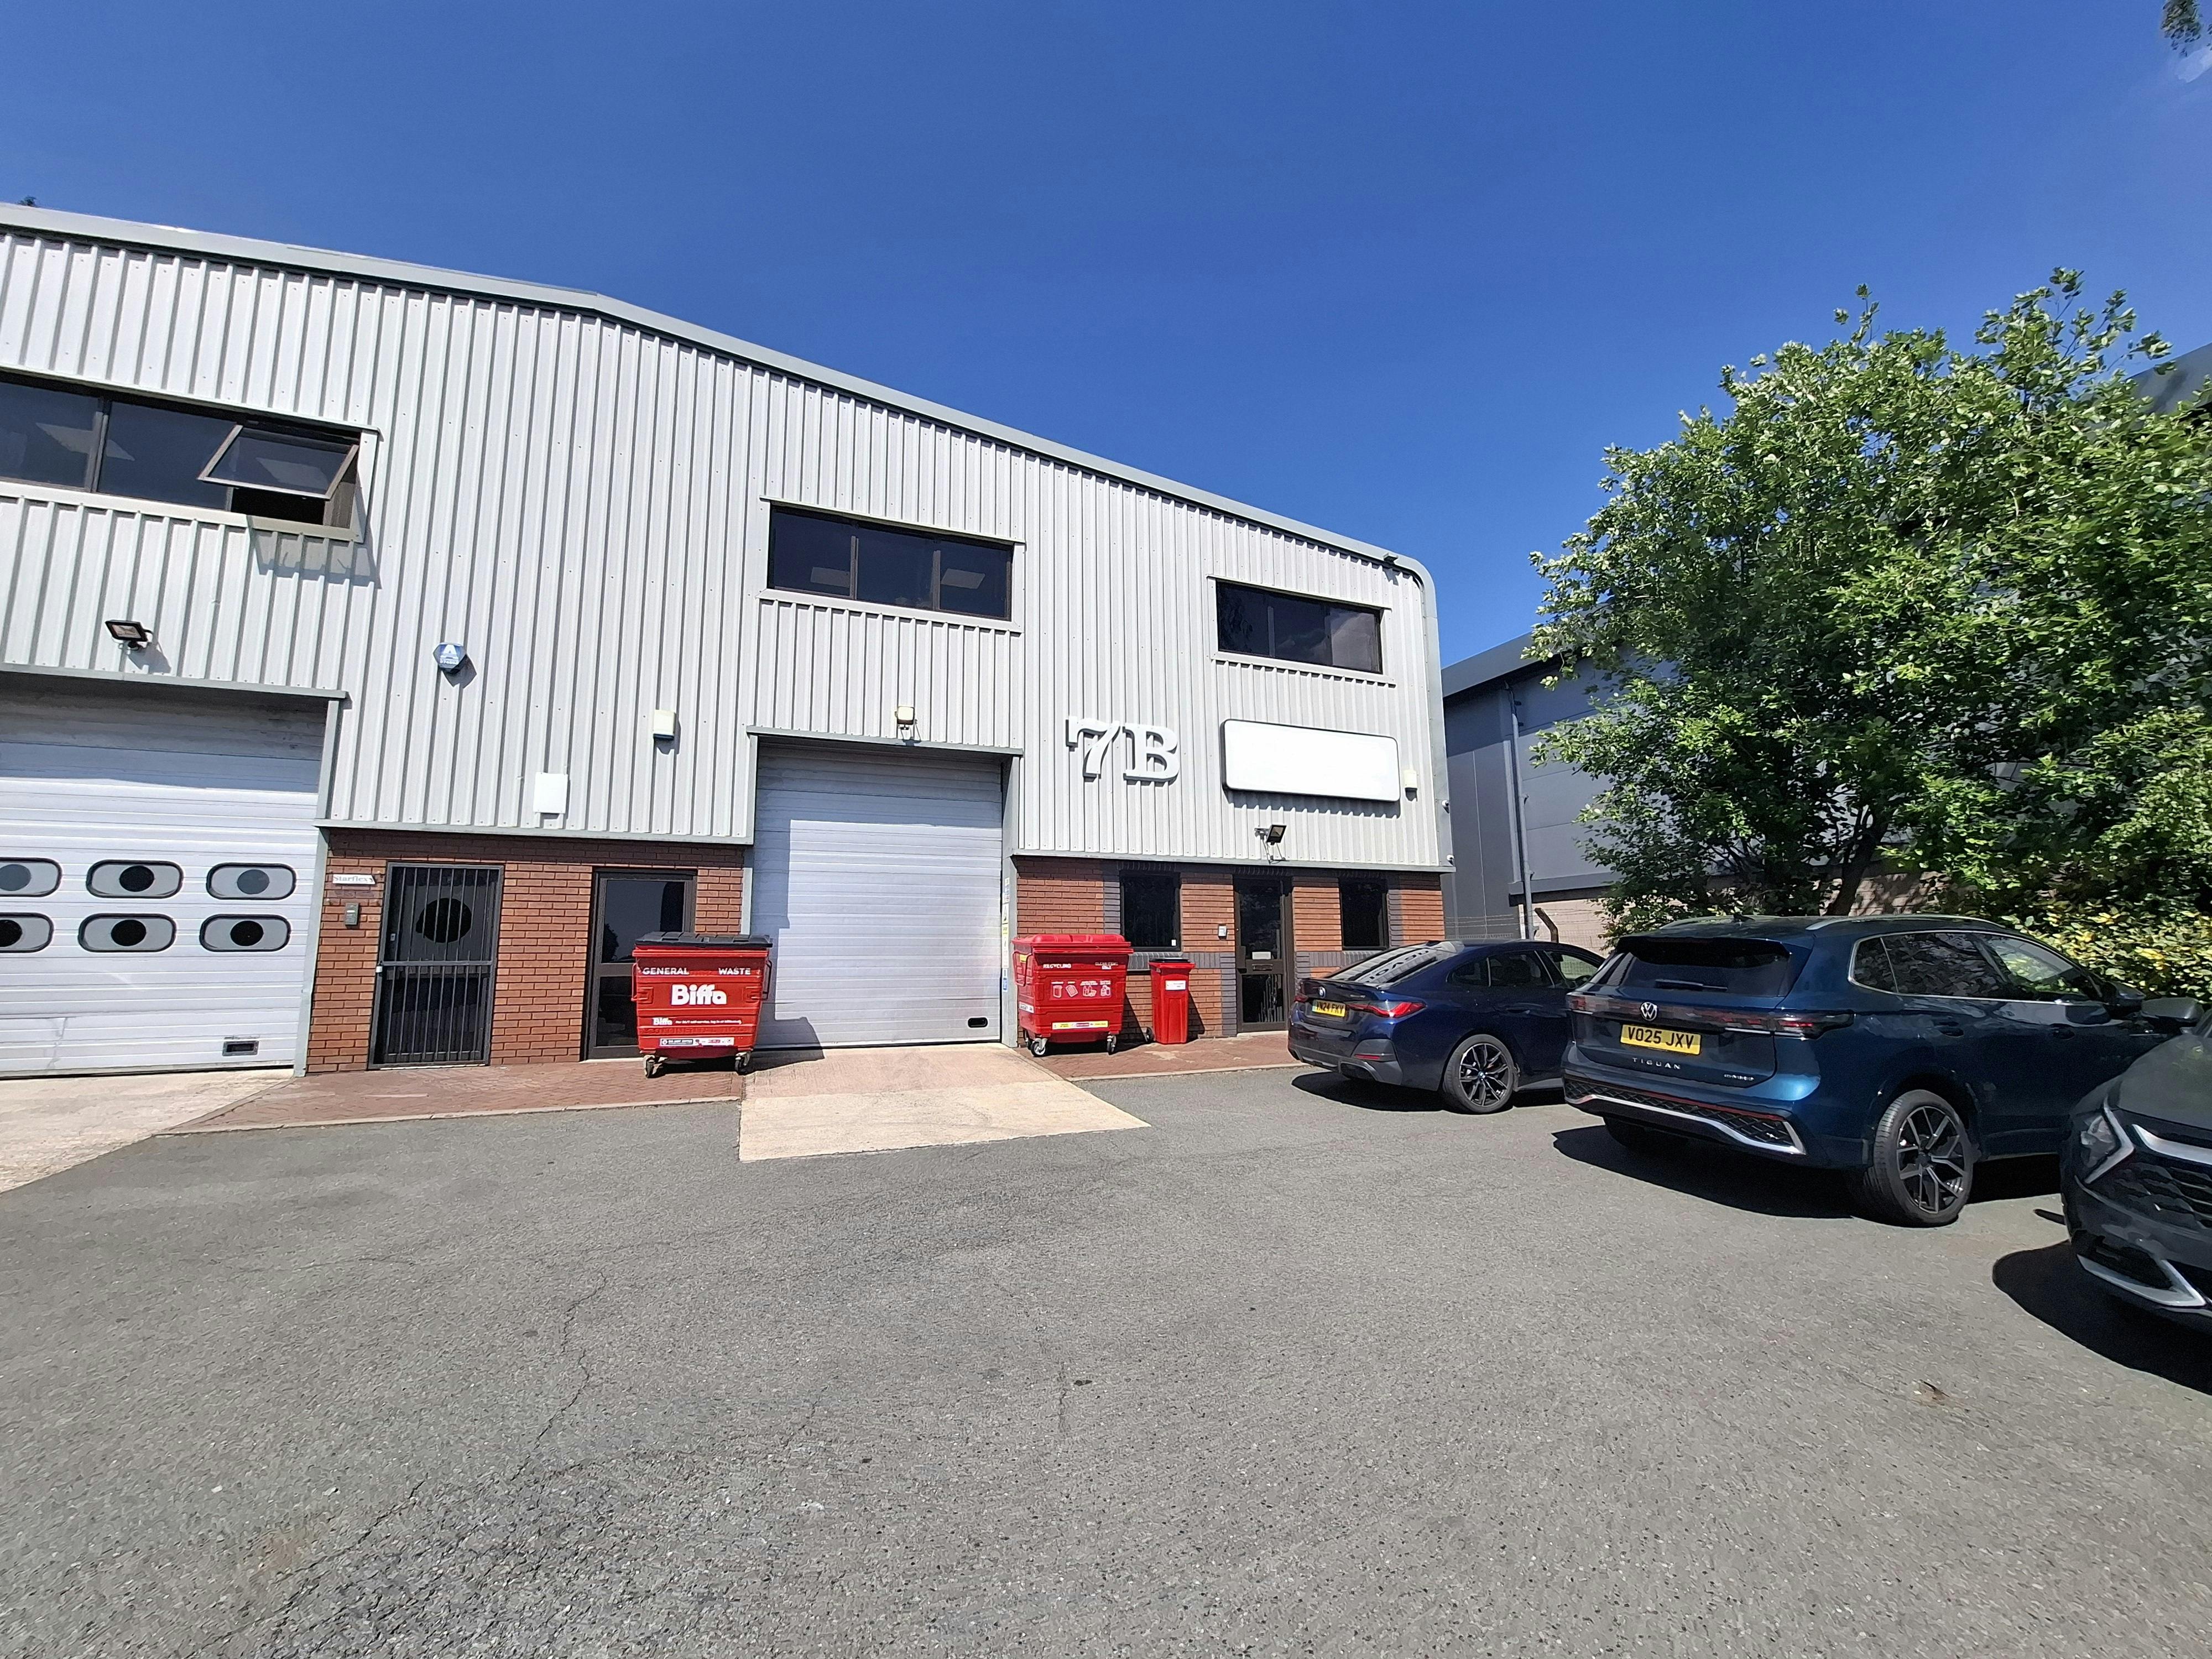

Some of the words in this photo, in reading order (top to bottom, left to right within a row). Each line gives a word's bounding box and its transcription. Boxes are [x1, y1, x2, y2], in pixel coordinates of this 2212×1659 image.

[1065, 715, 1180, 780] 7B
[671, 984, 727, 1005] Biffa
[653, 1017, 672, 1026] Biffa
[1628, 1026, 1662, 1044] VO25
[1665, 1032, 1694, 1049] JXV
[1632, 1057, 1681, 1070] TIGUAN
